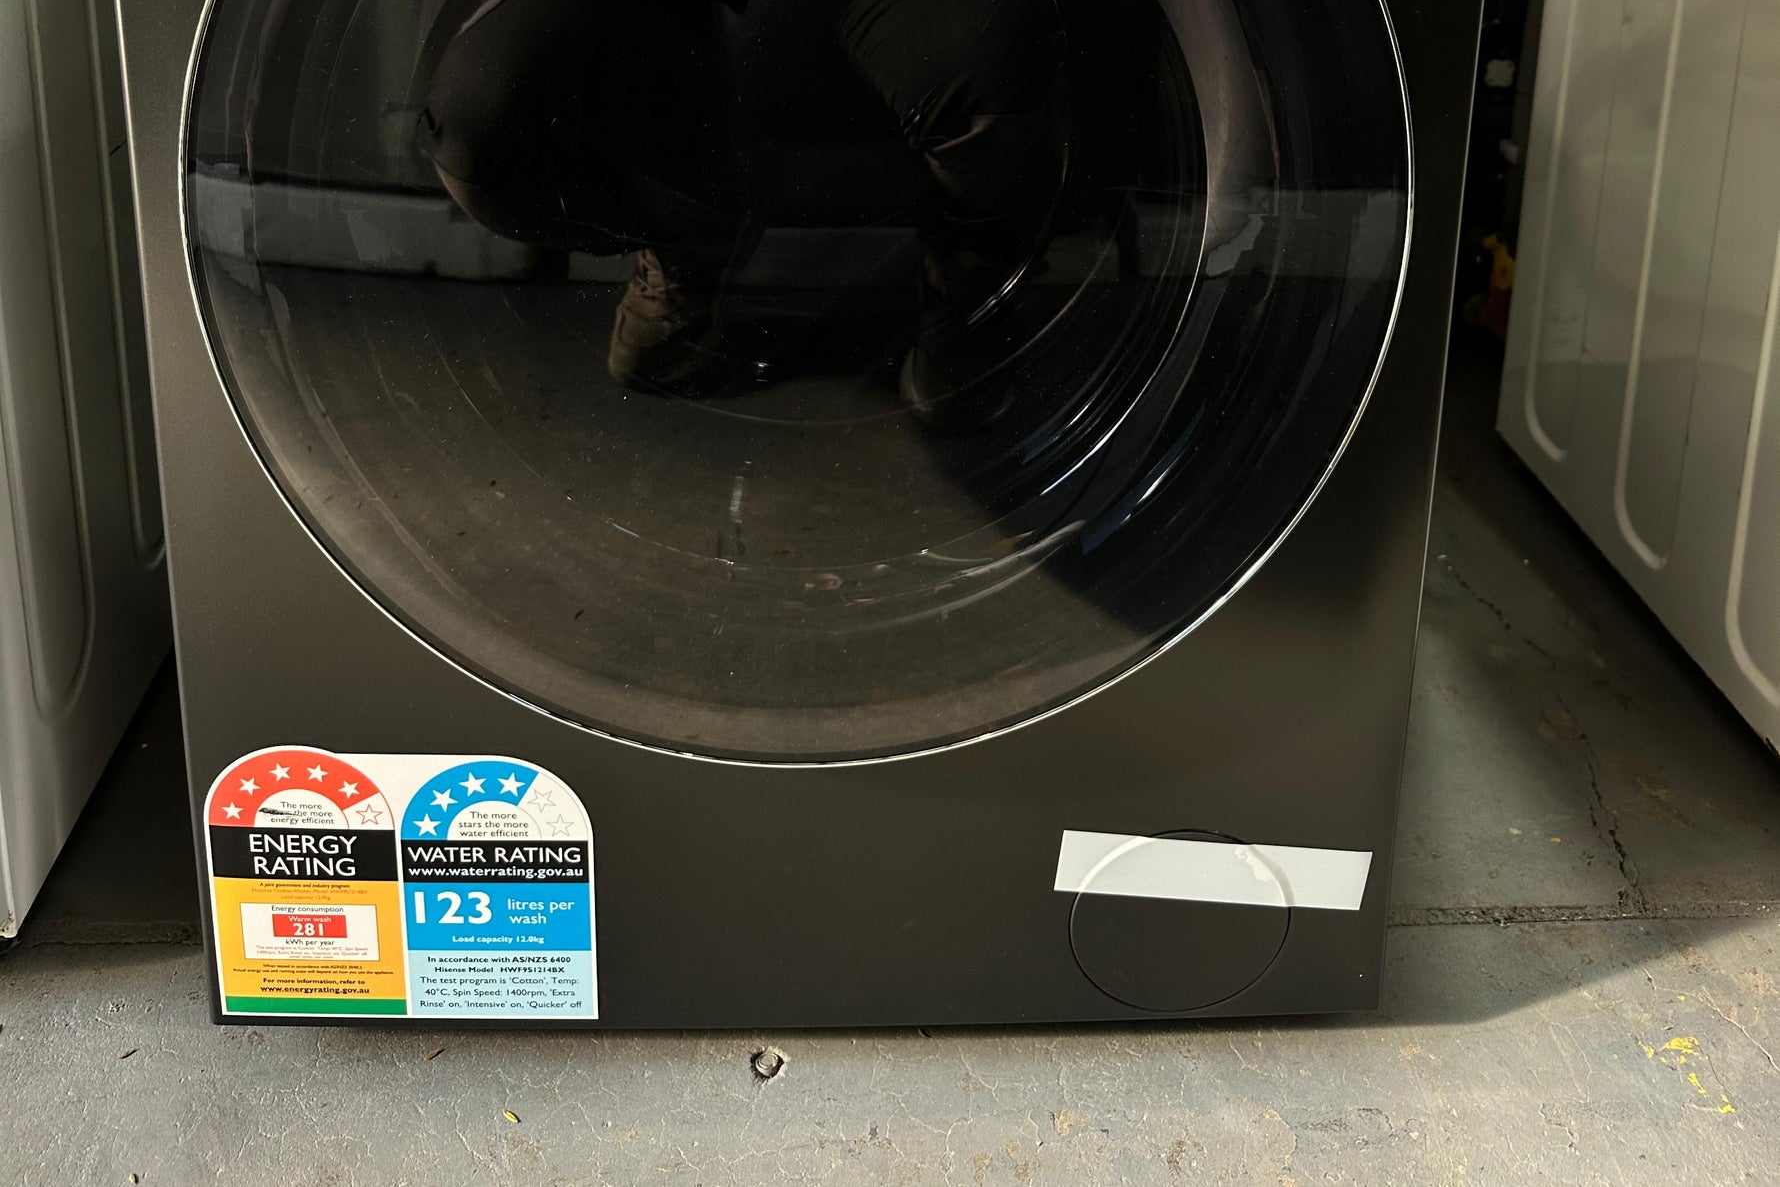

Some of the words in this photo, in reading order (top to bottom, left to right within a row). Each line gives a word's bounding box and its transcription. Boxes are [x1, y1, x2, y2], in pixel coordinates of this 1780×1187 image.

[280, 801, 297, 809] The
[470, 811, 489, 819] The
[270, 817, 299, 825] energy
[490, 829, 529, 837] efficient
[249, 834, 357, 854] ENERGY
[408, 847, 486, 863] WATER
[494, 847, 582, 863] RATING
[254, 856, 356, 876] RATING
[408, 866, 583, 879] www.waterrating.gov.au
[271, 905, 296, 913] Energy
[414, 891, 493, 924] 123
[507, 898, 544, 910] litres
[550, 901, 575, 913] per
[509, 913, 547, 924] wash
[292, 922, 324, 936] 281
[452, 935, 474, 943] Load
[477, 936, 513, 944] capacity
[516, 936, 544, 944] 12.0kg
[420, 976, 437, 984] The
[551, 977, 579, 985] Temp:
[260, 986, 370, 994] www.energyrating.gov.au
[453, 989, 471, 997] Spin
[474, 989, 502, 997] Speed:
[506, 989, 547, 998] 1400rpm,
